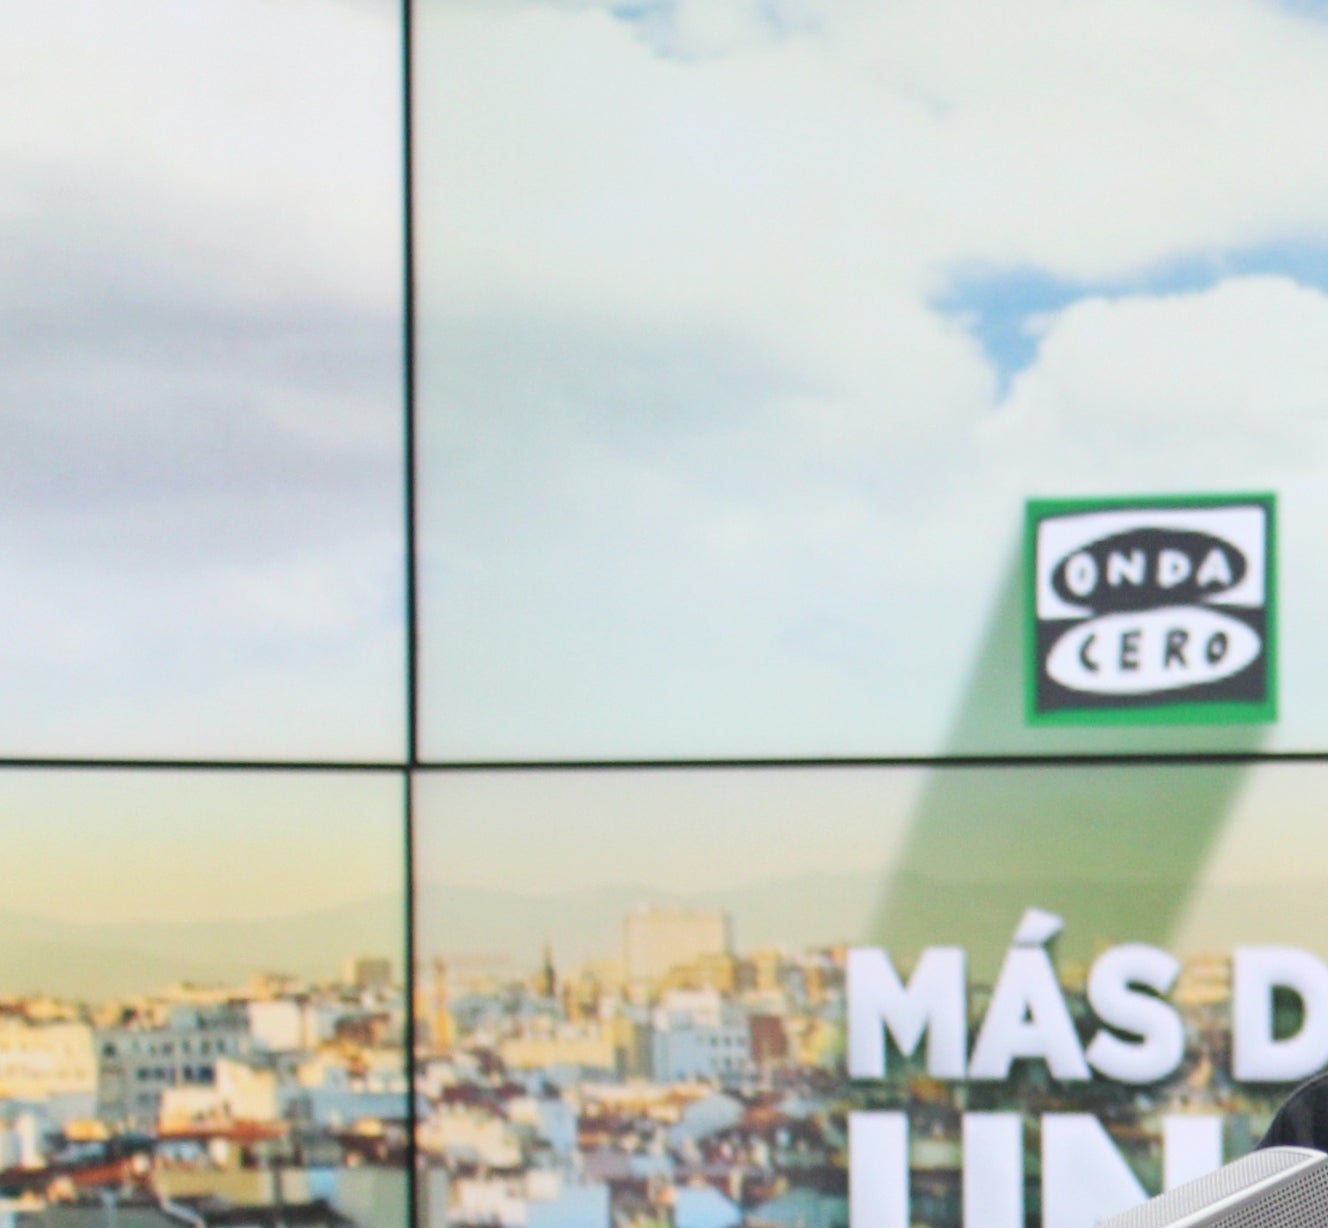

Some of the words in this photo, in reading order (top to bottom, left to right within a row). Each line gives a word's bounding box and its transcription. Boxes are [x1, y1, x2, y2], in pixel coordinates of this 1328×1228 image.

[1063, 547, 1233, 597] ONDA
[1078, 625, 1230, 673] CERO
[847, 908, 1186, 1082] MÁS
